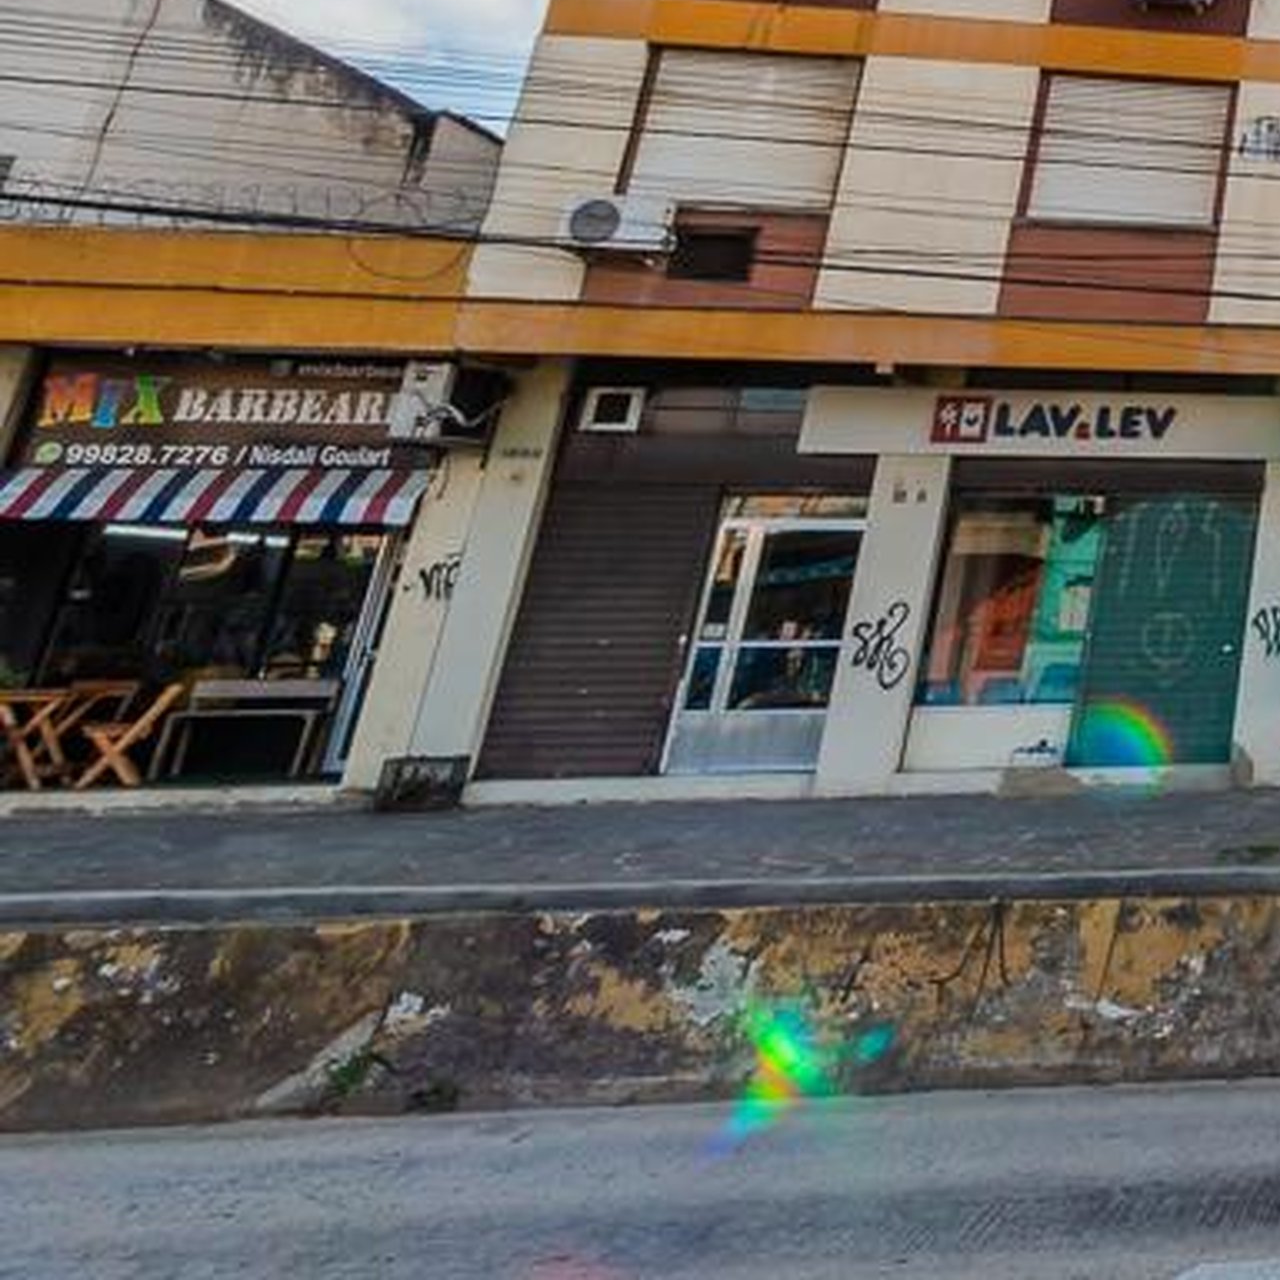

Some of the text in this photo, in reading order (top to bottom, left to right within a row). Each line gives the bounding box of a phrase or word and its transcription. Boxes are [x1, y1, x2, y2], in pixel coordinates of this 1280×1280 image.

[38, 371, 390, 428] MIX BARBEAR
[65, 444, 230, 466] 99828.7276
